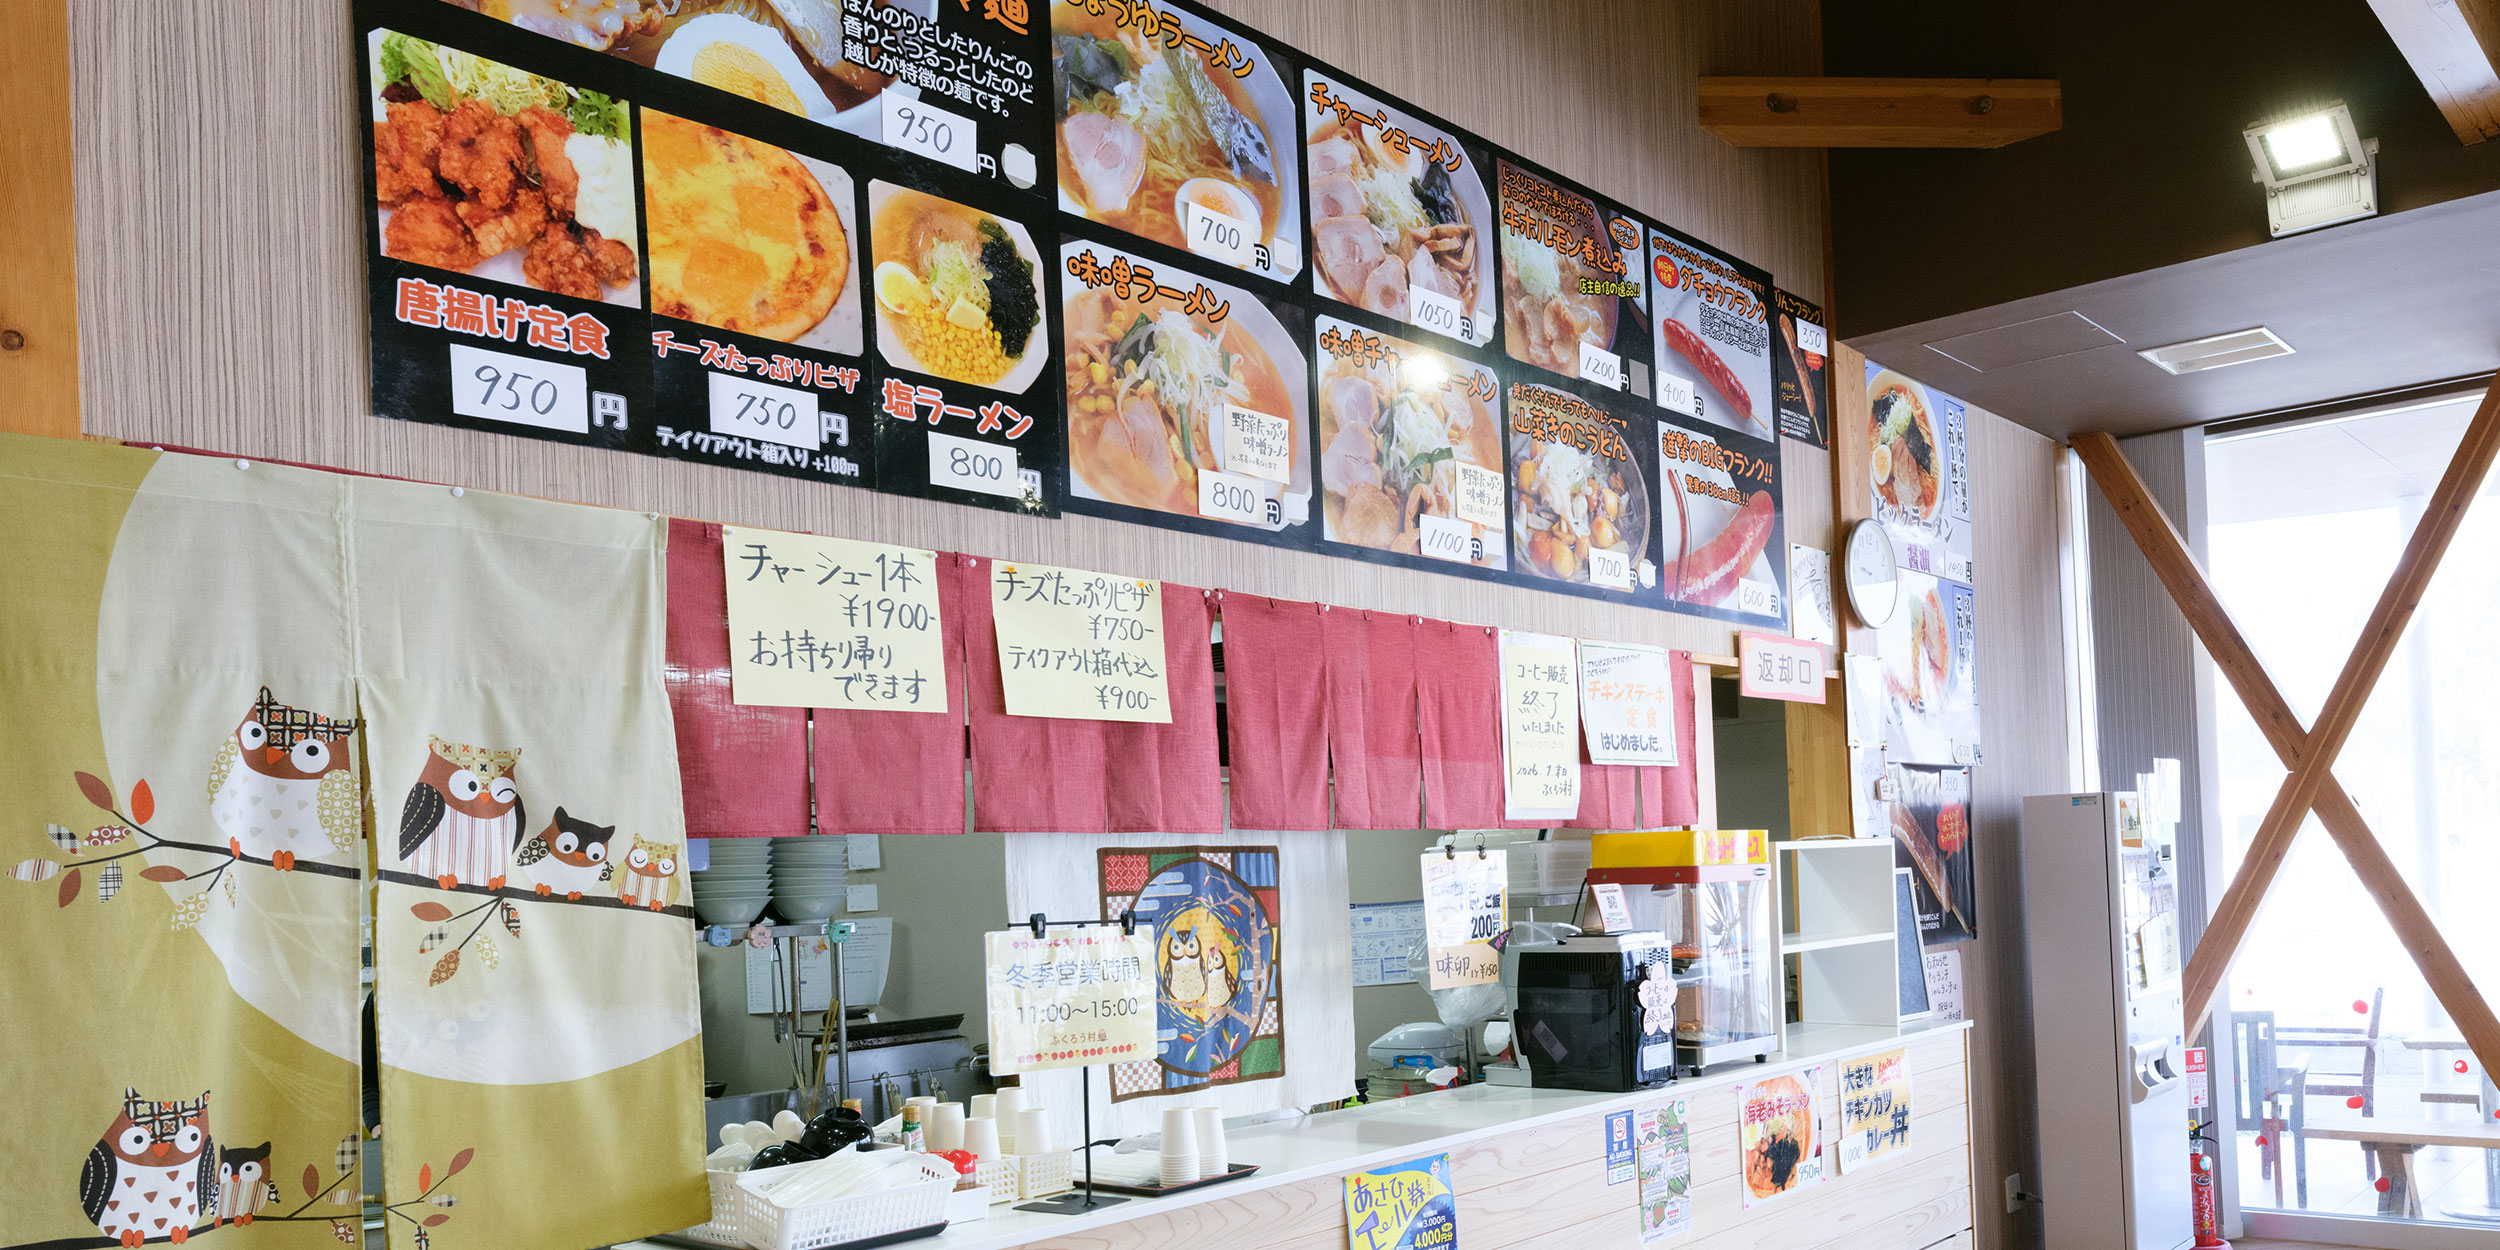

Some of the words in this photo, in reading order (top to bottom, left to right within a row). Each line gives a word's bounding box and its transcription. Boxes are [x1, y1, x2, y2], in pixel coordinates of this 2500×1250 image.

[843, 0, 1034, 79] ほんのりとしたりんごの
[843, 14, 1034, 104] 香りと、つるっとしたのど
[843, 38, 1010, 118] 越しが特徴の麺です。
[897, 107, 953, 154] 950
[976, 152, 997, 179] 円
[1310, 82, 1463, 173] チャーシューメン
[1200, 216, 1241, 251] 700
[1502, 201, 1628, 276] 牛ホルモン煮込み
[1066, 247, 1231, 323] 味噌ラーメン
[395, 279, 610, 360] 唐揚げ定食
[1416, 300, 1454, 330] 1050
[1802, 326, 1823, 348] 350
[651, 330, 861, 394] チーズたっぷりピザ
[1584, 355, 1617, 382] 1200
[475, 363, 559, 416] 950
[592, 390, 629, 431] 円
[881, 378, 1035, 440] 塩ラーメン
[1663, 384, 1687, 406] 400
[734, 391, 798, 431] 750
[819, 410, 850, 446] 円
[1513, 404, 1628, 462] 山菜きのこうどん
[656, 425, 808, 470] テイクアウト箱入り
[949, 446, 1003, 481] 800
[1662, 428, 1774, 485] 進撃のBIGフランク!!
[1212, 481, 1256, 515] 800
[1428, 528, 1465, 554] 1100
[739, 542, 923, 594] チャーシュー1本
[1598, 555, 1623, 579] 700
[996, 569, 1155, 613] チーズたっぷりピザ
[1743, 585, 1764, 607] 600
[748, 629, 893, 673] お持ち帰り
[1757, 651, 1813, 685] 返却口
[833, 668, 928, 705] できます
[1518, 689, 1559, 720] 終了
[1587, 680, 1665, 705] チキンステーキ
[1626, 705, 1657, 729] 定食
[1006, 956, 1141, 990] 冬季営業時間
[1436, 952, 1470, 979] 味卵
[1050, 1031, 1097, 1046] ふくろう村
[1843, 1063, 1874, 1095] 大きな
[1745, 1094, 1811, 1127] 海老みそラーメン
[1845, 1088, 1893, 1125] チキンカツ
[1353, 1176, 1405, 1214] あさひ
